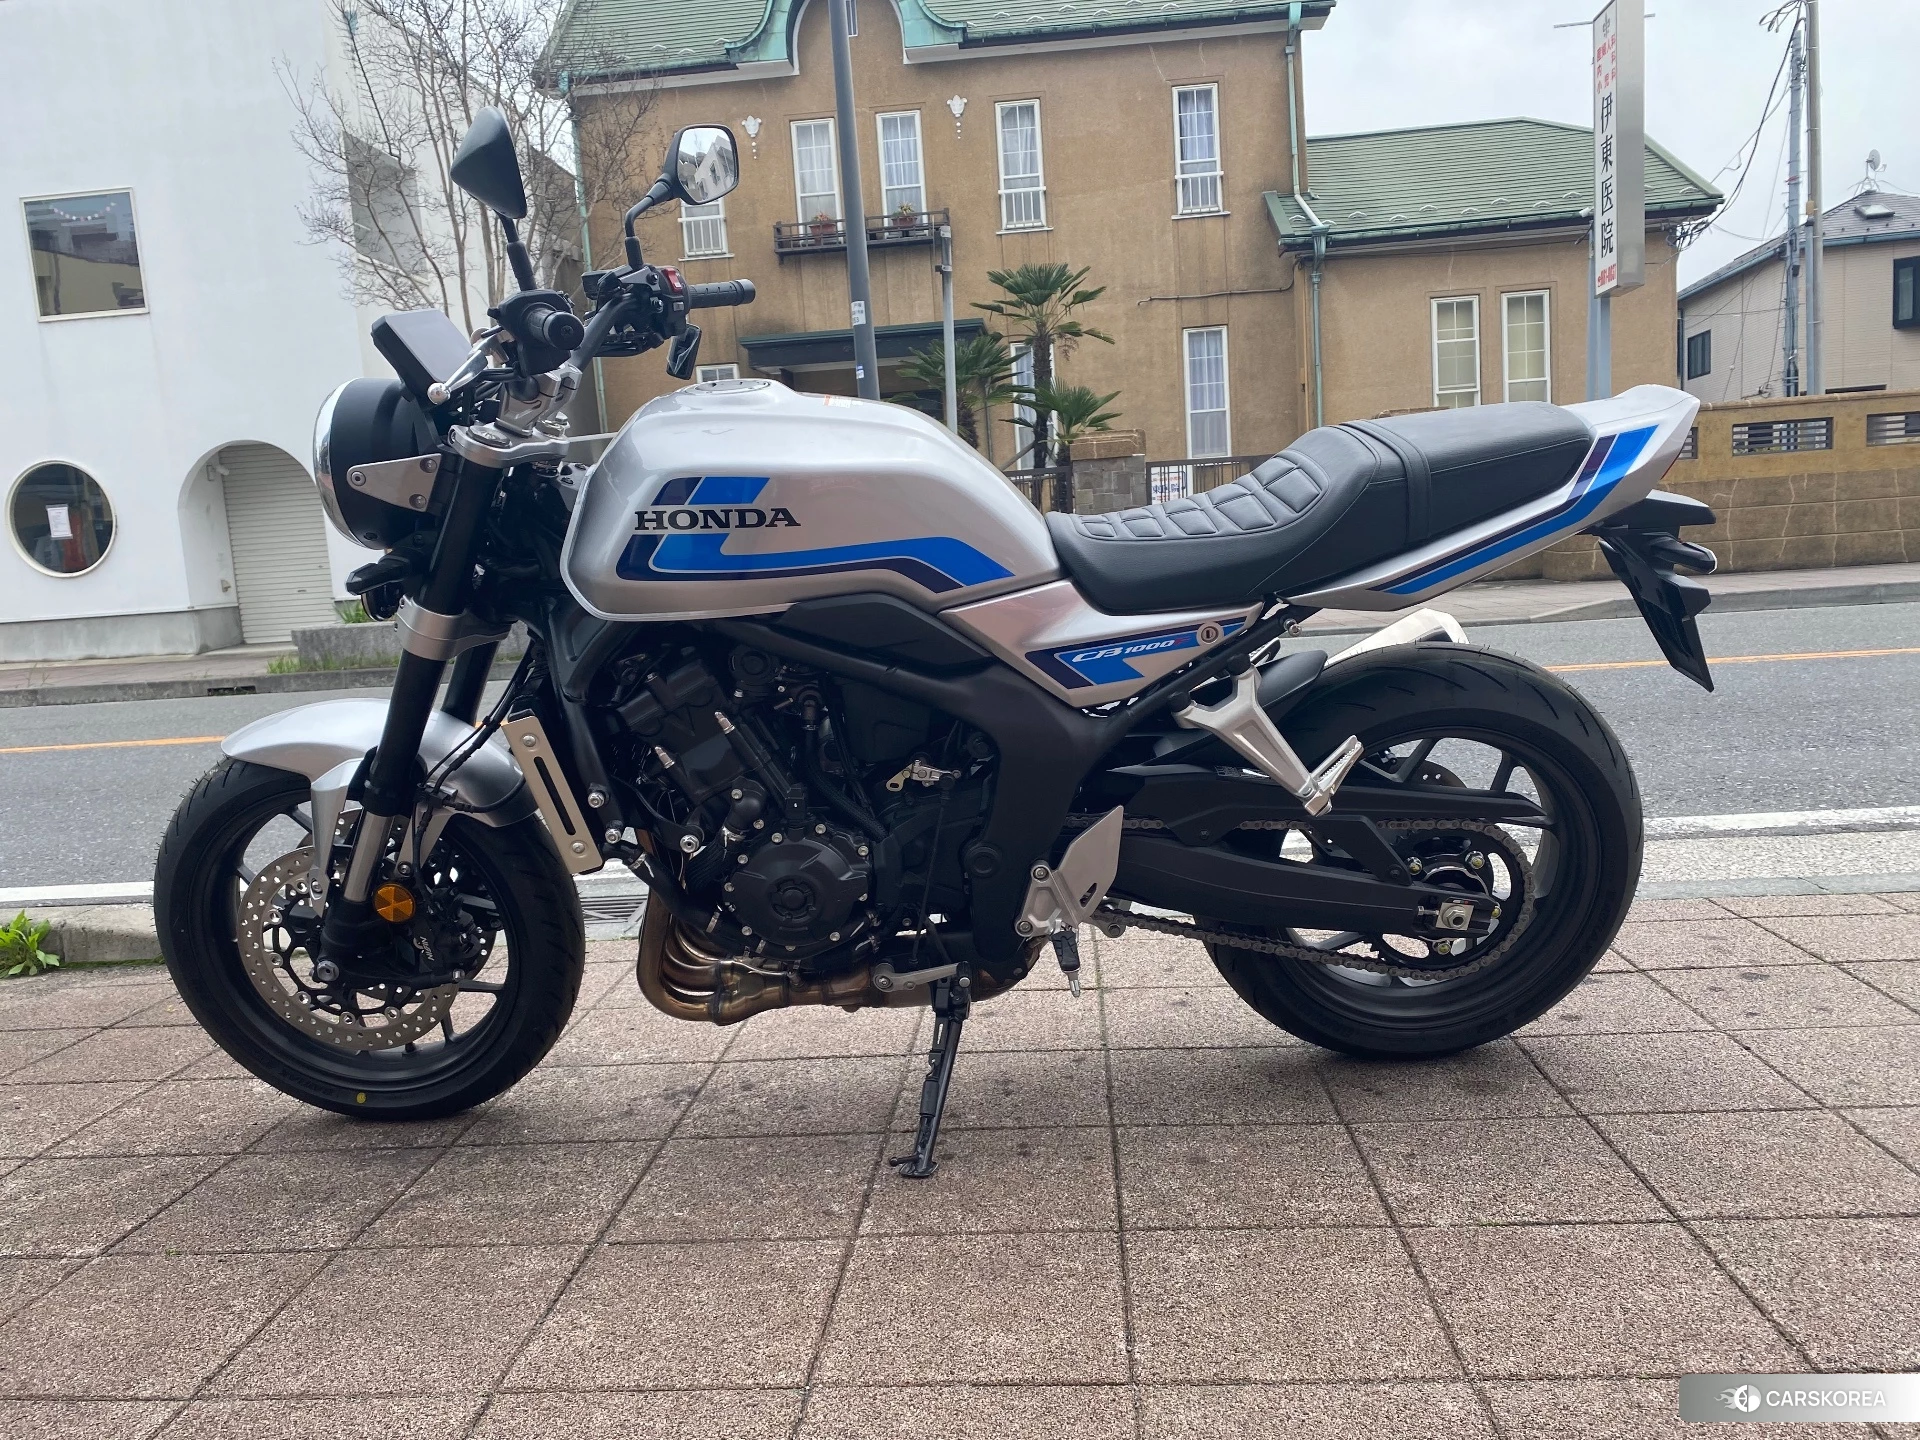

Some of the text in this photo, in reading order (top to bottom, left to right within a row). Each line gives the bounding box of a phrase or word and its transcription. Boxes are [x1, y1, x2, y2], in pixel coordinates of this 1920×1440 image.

[1600, 91, 1614, 259] 伊東医院
[634, 507, 802, 531] HONDA
